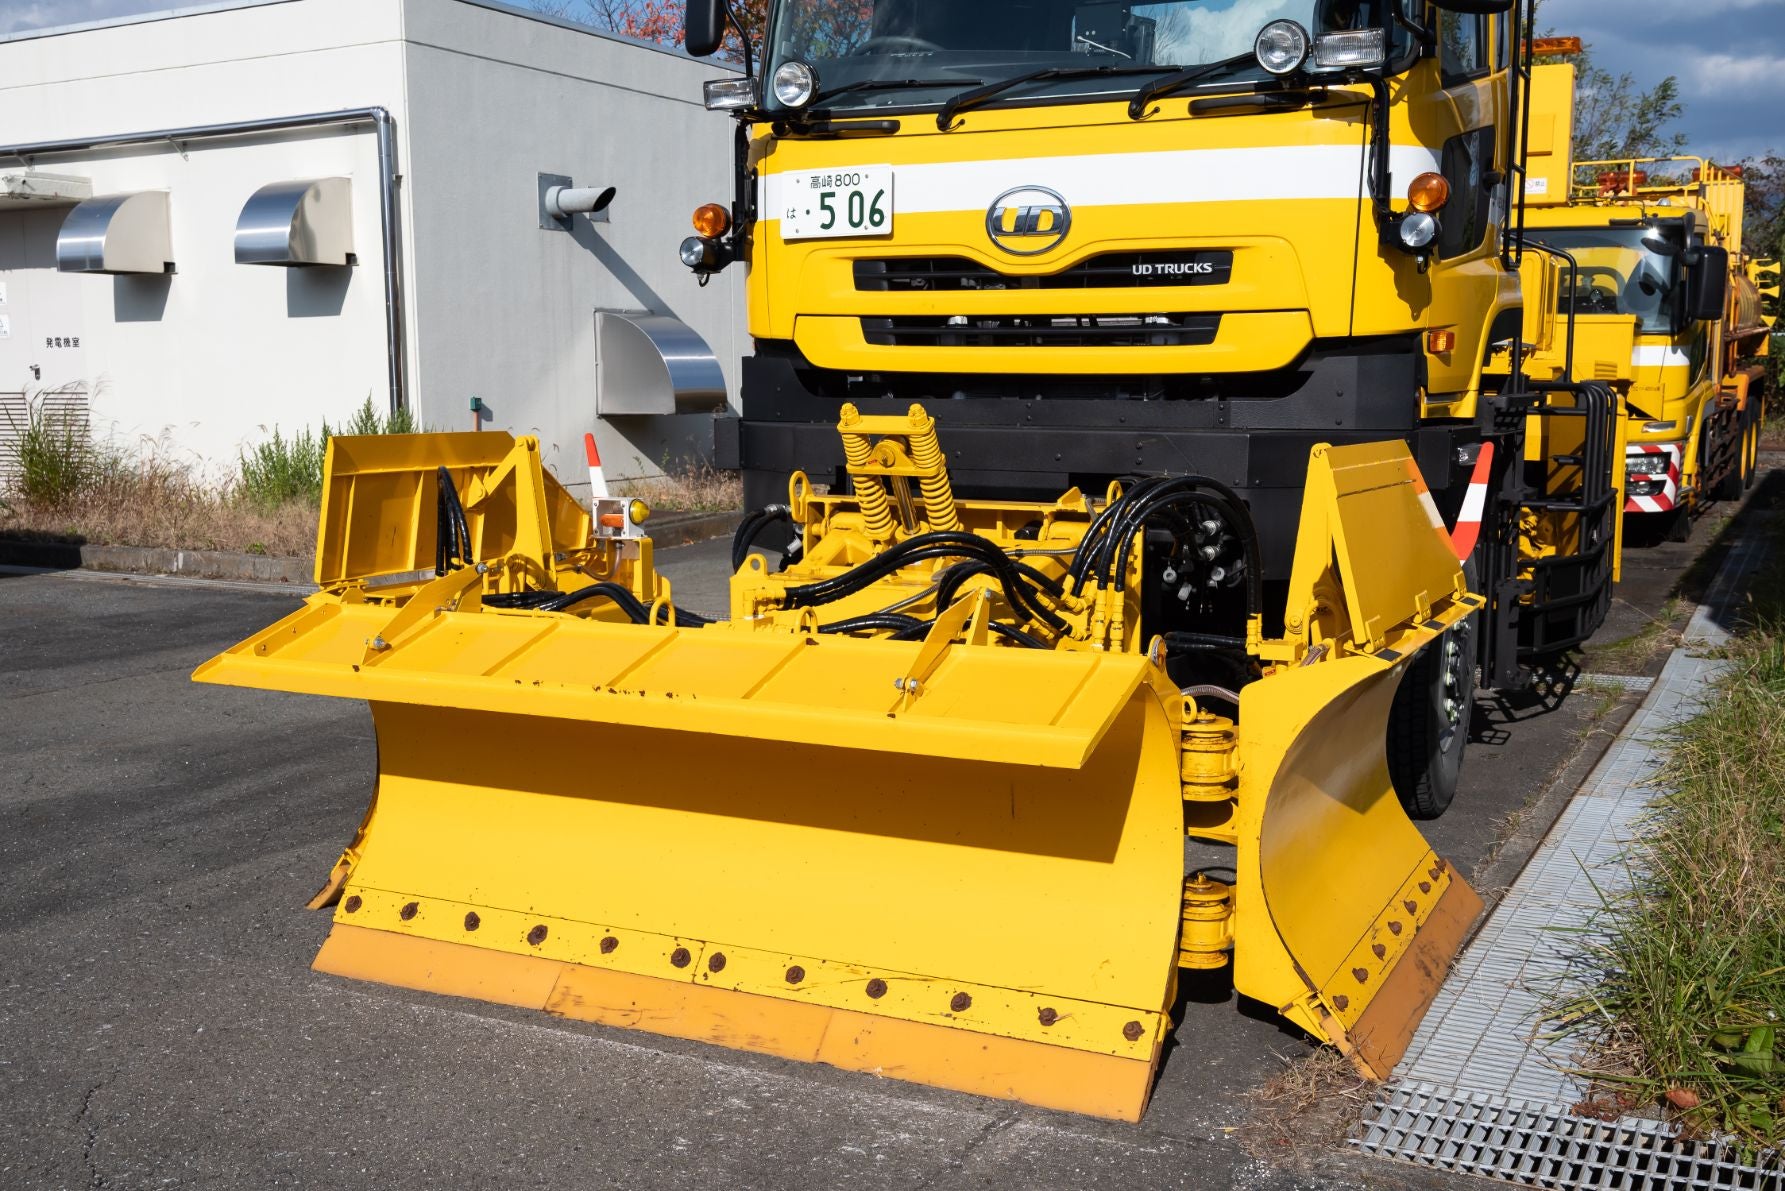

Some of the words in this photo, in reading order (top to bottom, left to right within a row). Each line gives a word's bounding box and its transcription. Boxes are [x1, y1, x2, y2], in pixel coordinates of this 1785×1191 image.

[786, 207, 797, 220] は
[992, 204, 1064, 237] UD
[1132, 264, 1153, 275] UD
[1155, 262, 1213, 274] TRUCKS
